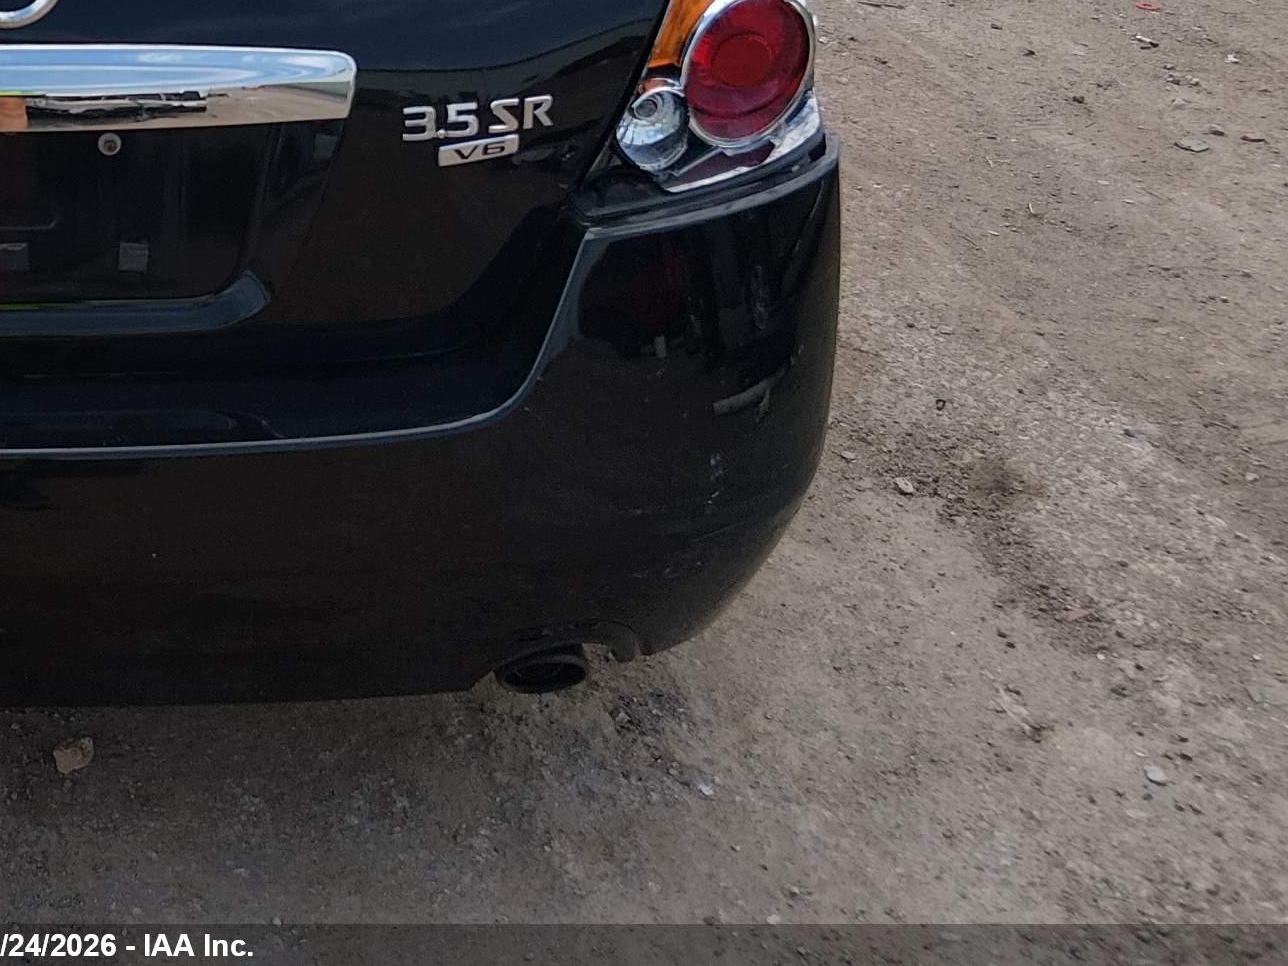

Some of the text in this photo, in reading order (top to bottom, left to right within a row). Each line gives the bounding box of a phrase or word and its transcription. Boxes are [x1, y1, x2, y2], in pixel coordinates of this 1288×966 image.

[402, 94, 554, 142] 3.5 SR
[454, 141, 505, 160] V6
